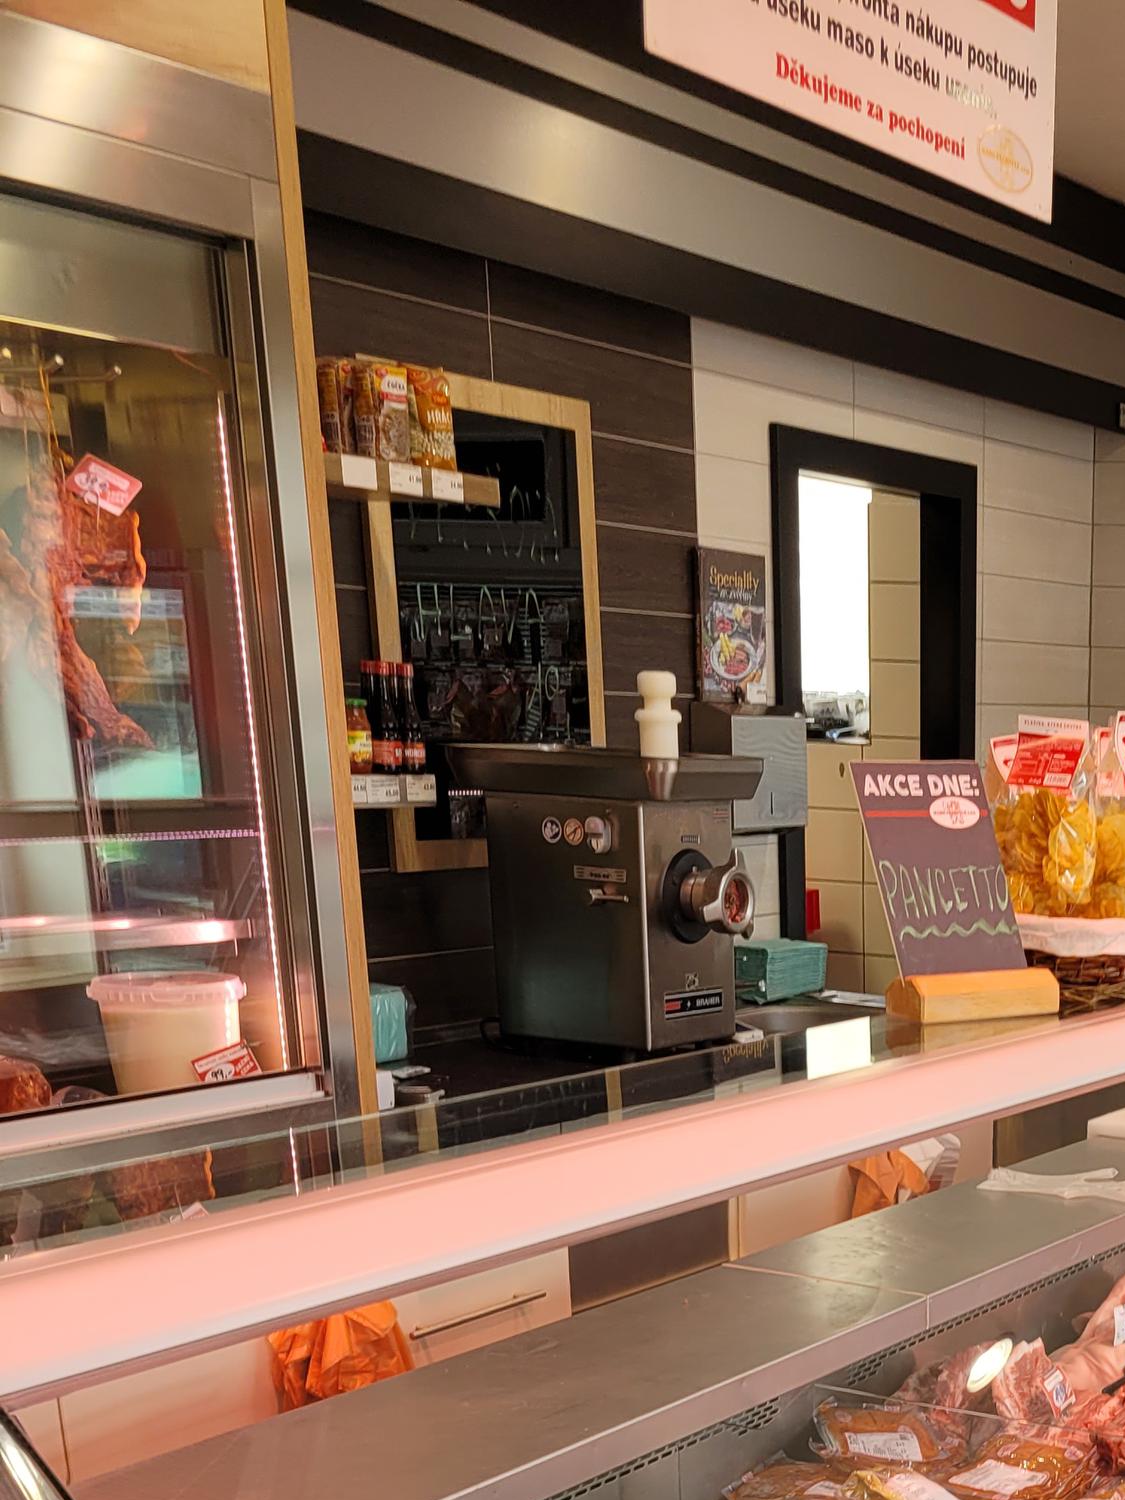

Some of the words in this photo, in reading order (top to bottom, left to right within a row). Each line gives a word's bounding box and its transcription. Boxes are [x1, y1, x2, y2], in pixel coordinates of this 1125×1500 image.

[775, 52, 862, 113] Děkujeme
[866, 98, 883, 123] za
[827, 16, 874, 58] maso
[880, 36, 889, 67] k
[894, 42, 940, 91] úseku
[906, 8, 963, 59] nákupu
[968, 43, 1037, 101] postupuje
[864, 773, 924, 797] AKCE
[927, 773, 980, 797] DNE:
